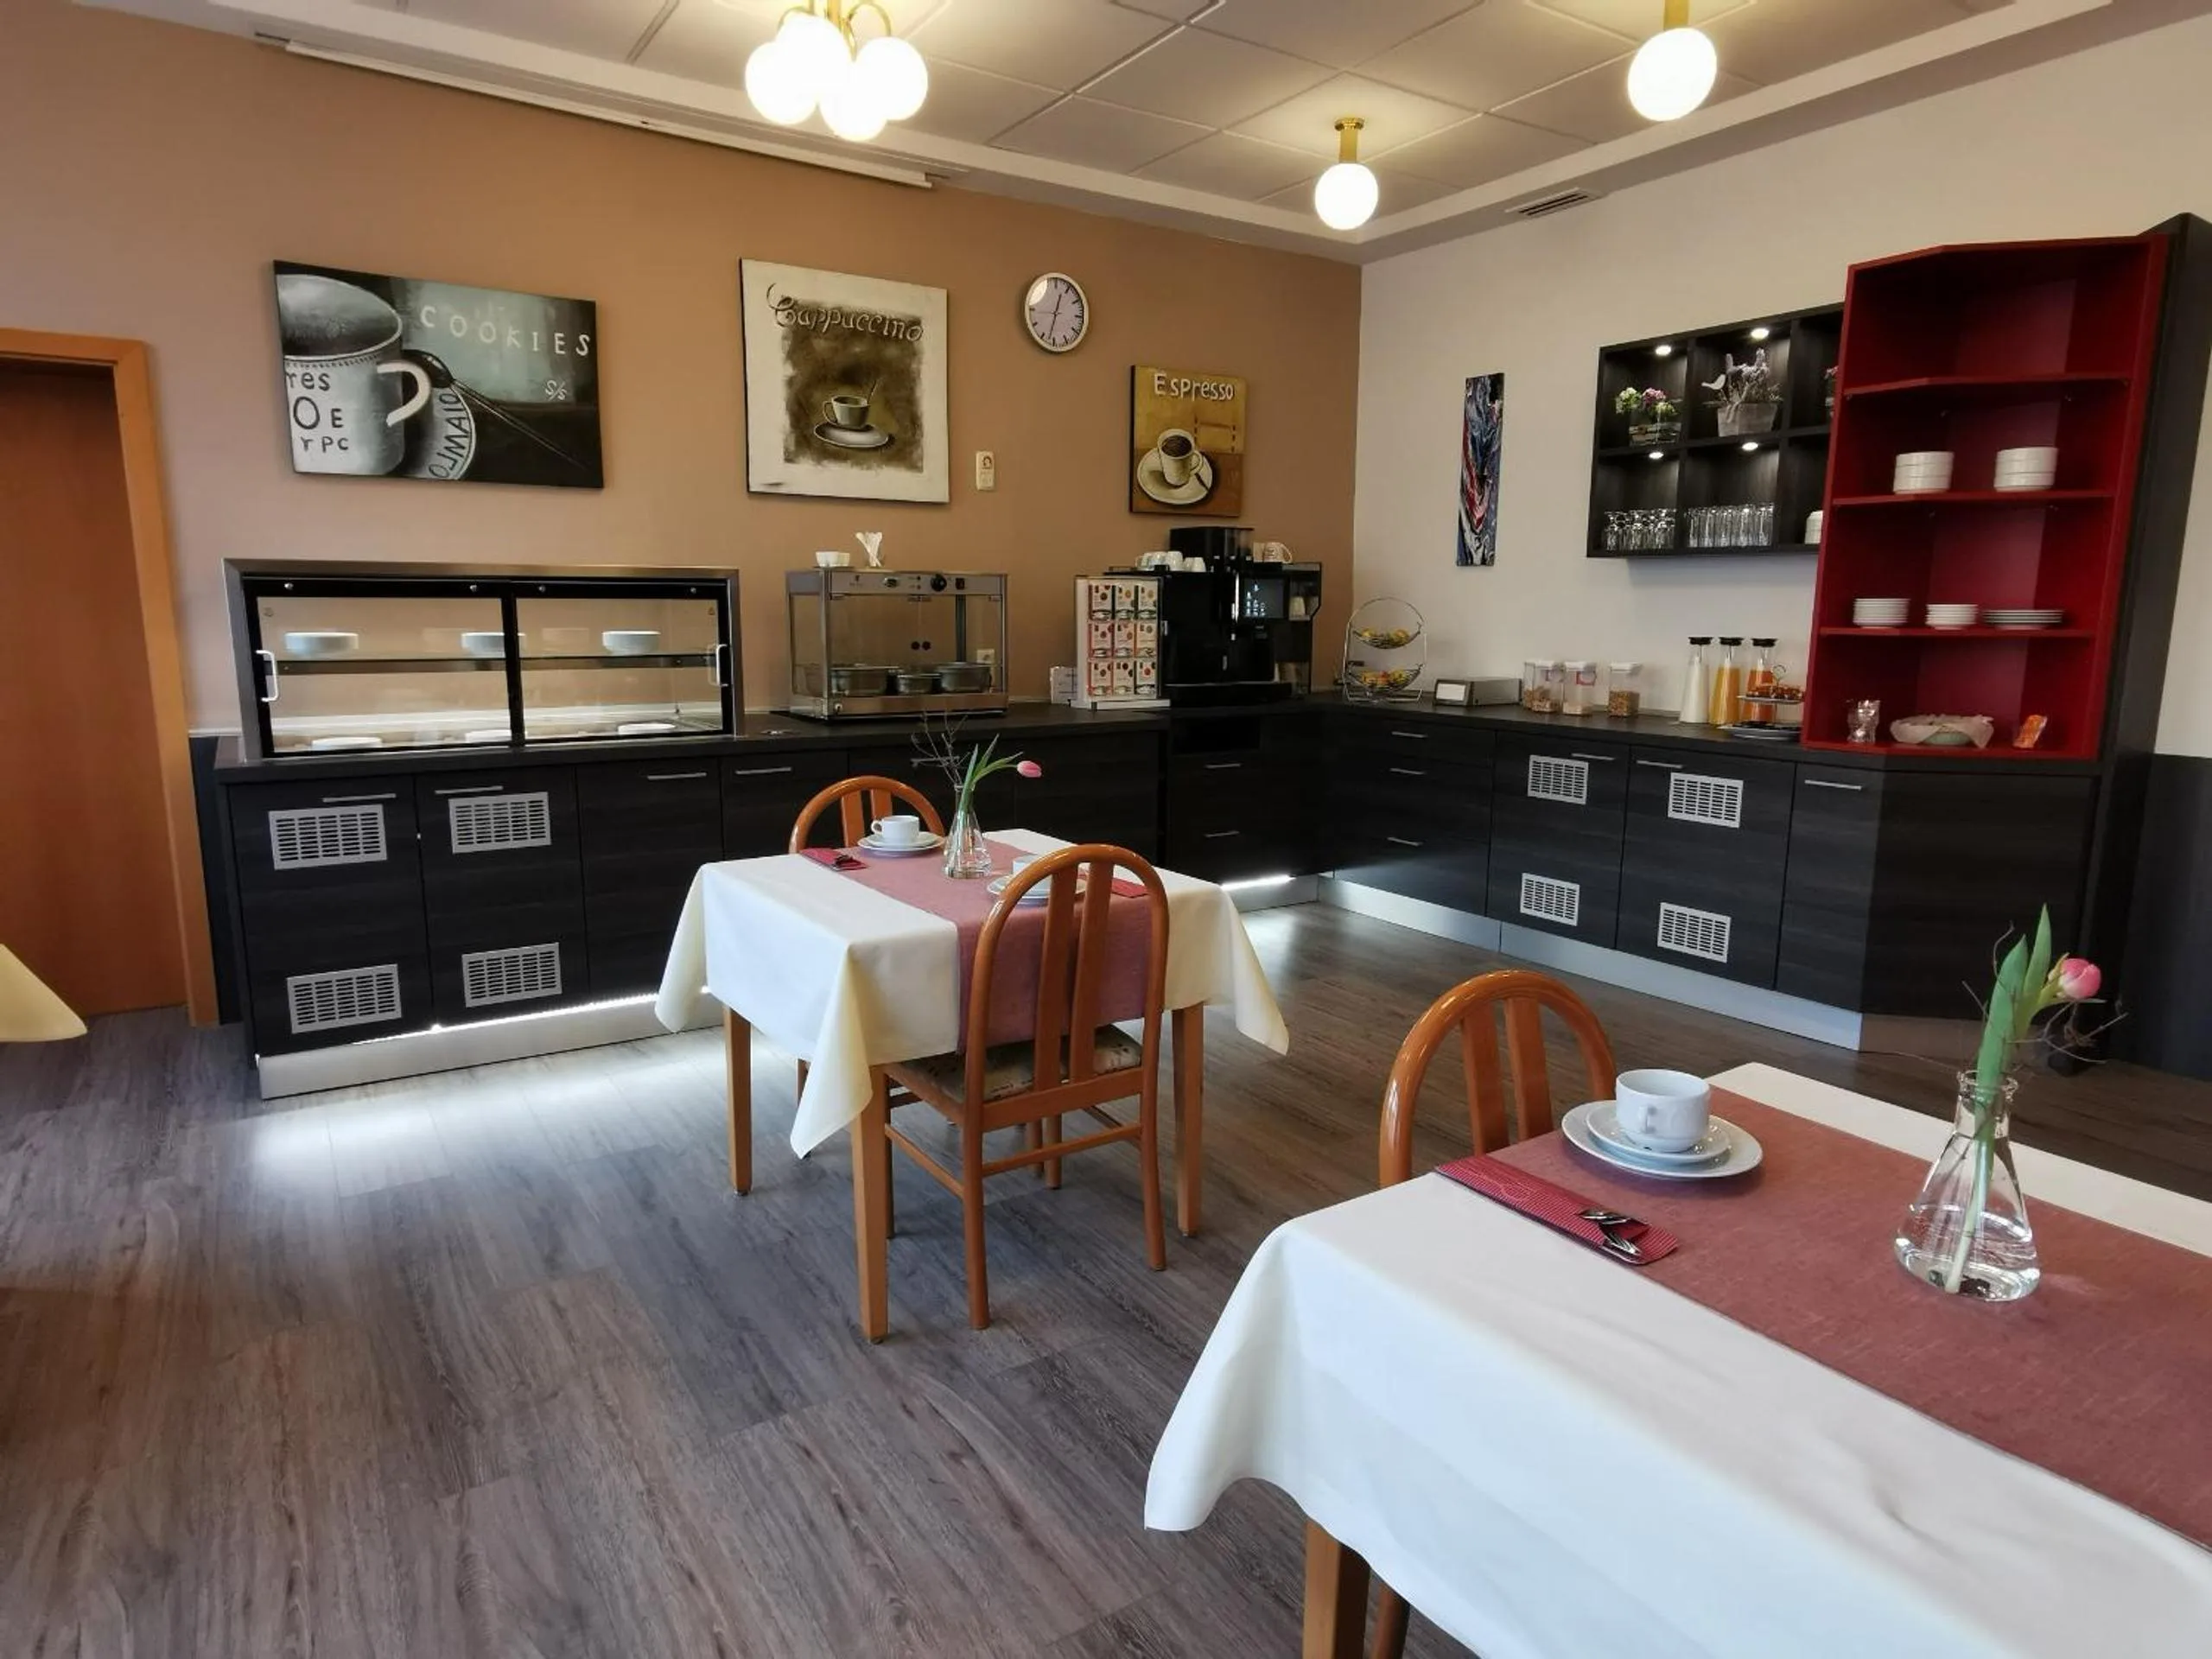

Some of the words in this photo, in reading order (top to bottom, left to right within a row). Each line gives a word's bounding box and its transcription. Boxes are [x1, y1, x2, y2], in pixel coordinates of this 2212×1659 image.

[420, 306, 590, 357] COOKIES
[766, 283, 925, 341] Cappuccino
[1154, 373, 1234, 401] Espresso
